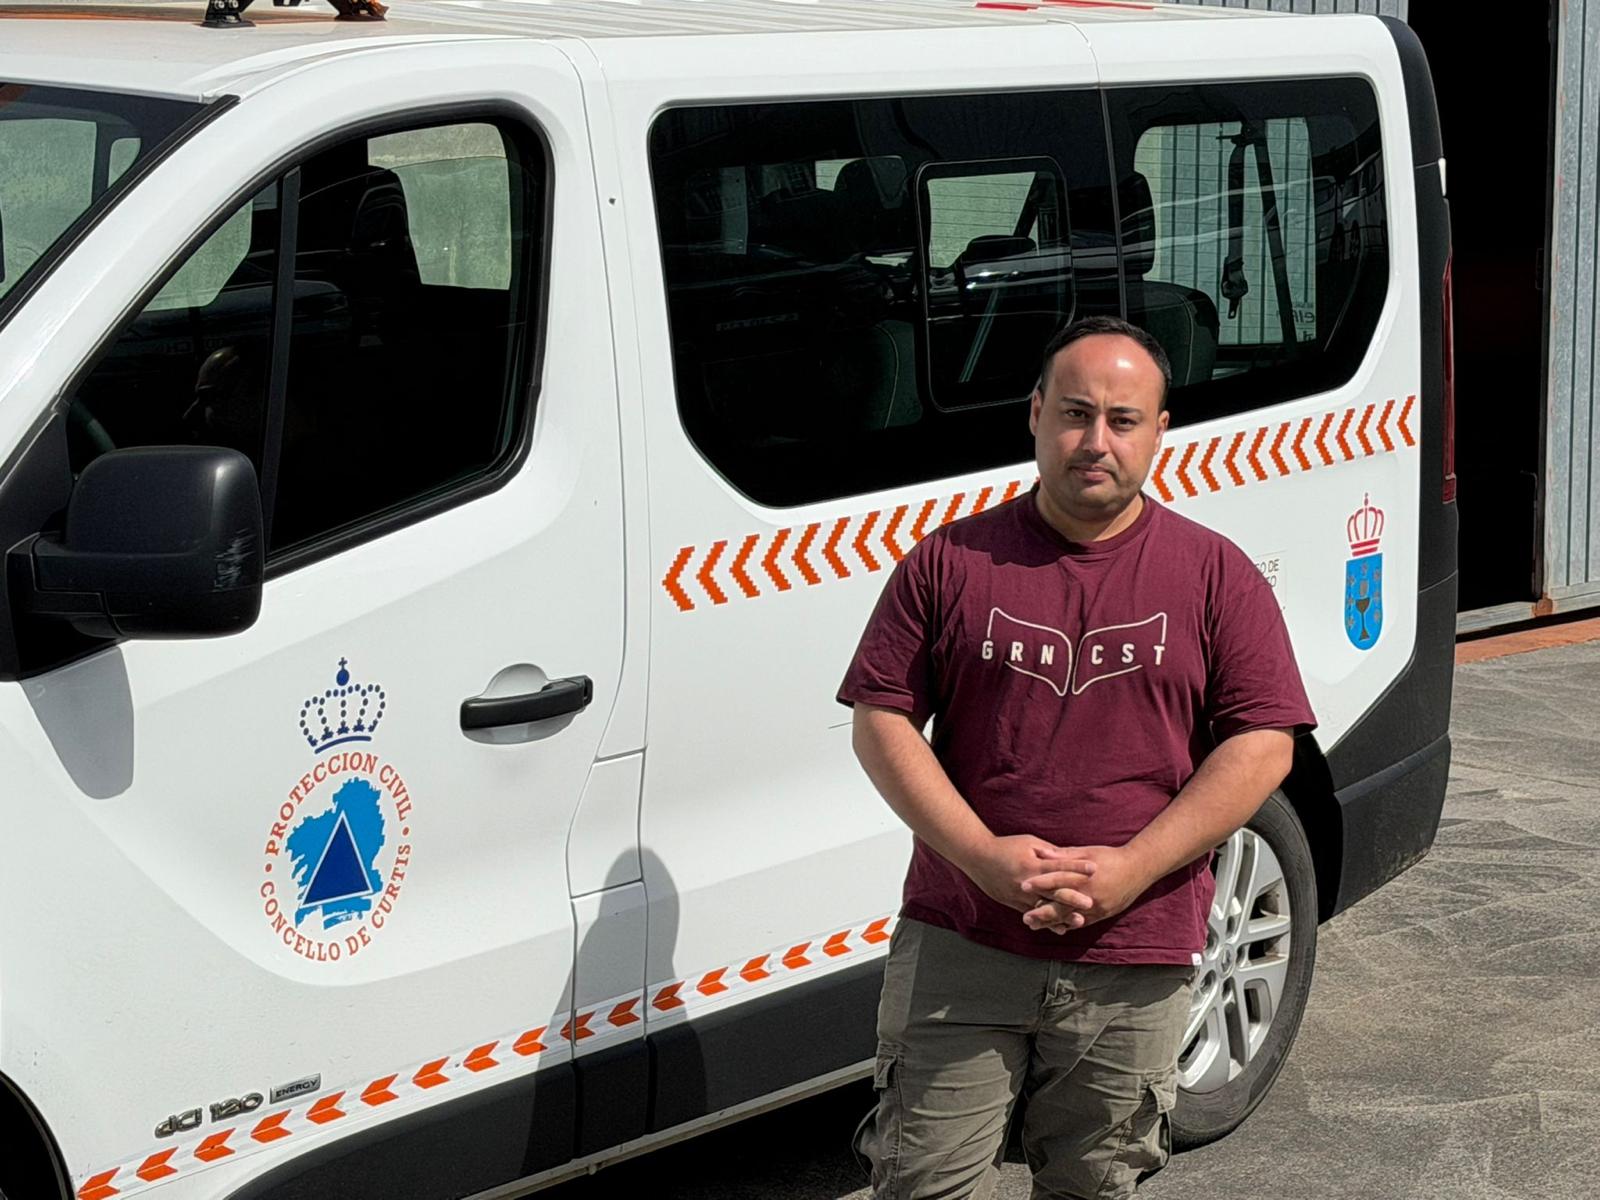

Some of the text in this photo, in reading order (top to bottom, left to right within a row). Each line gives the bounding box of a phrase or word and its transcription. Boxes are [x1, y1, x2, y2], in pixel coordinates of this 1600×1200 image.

[265, 752, 412, 855] PROTECCION CIVIL
[260, 844, 411, 961] CONCELLO DE CURTIS
[209, 1092, 264, 1123] 120
[275, 1079, 318, 1098] ENERGY
